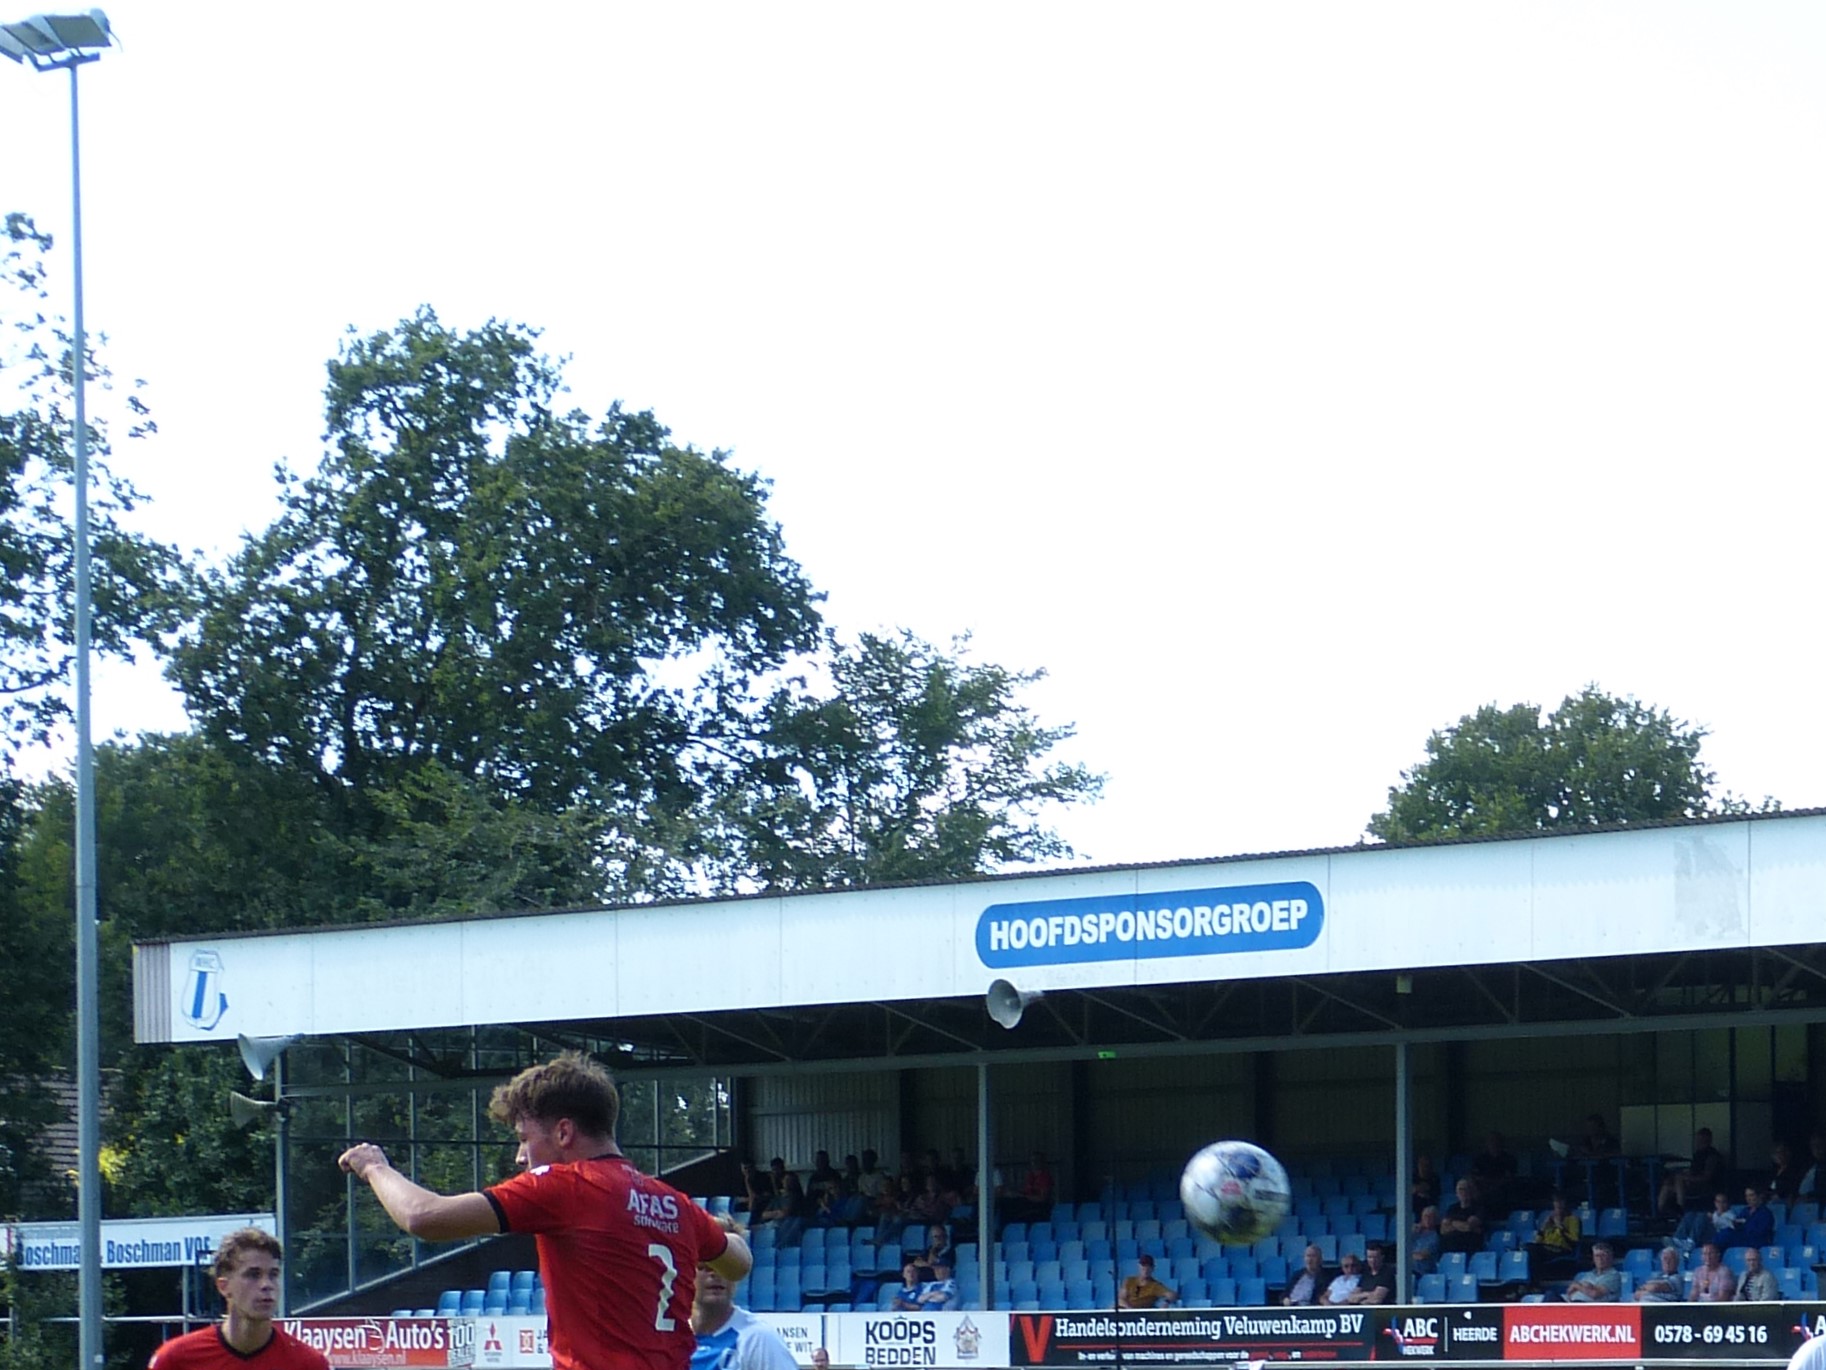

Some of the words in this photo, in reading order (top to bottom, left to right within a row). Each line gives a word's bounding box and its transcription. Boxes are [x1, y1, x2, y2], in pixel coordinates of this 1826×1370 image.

[990, 898, 1309, 951] HOOFDSPONSORGROEP
[627, 1188, 679, 1220] AFAS
[16, 1241, 81, 1266] Boschma
[107, 1239, 182, 1264] Boschman
[648, 1243, 678, 1332] 2
[386, 1320, 445, 1349] Auto's
[1055, 1316, 1222, 1341] Handelsonderneming
[1223, 1315, 1337, 1339] Veluwenkamp
[1339, 1314, 1365, 1334] BV
[1403, 1317, 1439, 1338] ABC
[1452, 1327, 1498, 1342] HEERDE
[1509, 1324, 1636, 1344] ABCHEKWERK.NL
[1654, 1325, 1692, 1343] 0578
[1703, 1326, 1723, 1343] 69
[1725, 1326, 1745, 1343] 45
[1748, 1325, 1768, 1343] 16
[865, 1346, 936, 1365] BEDDEN
